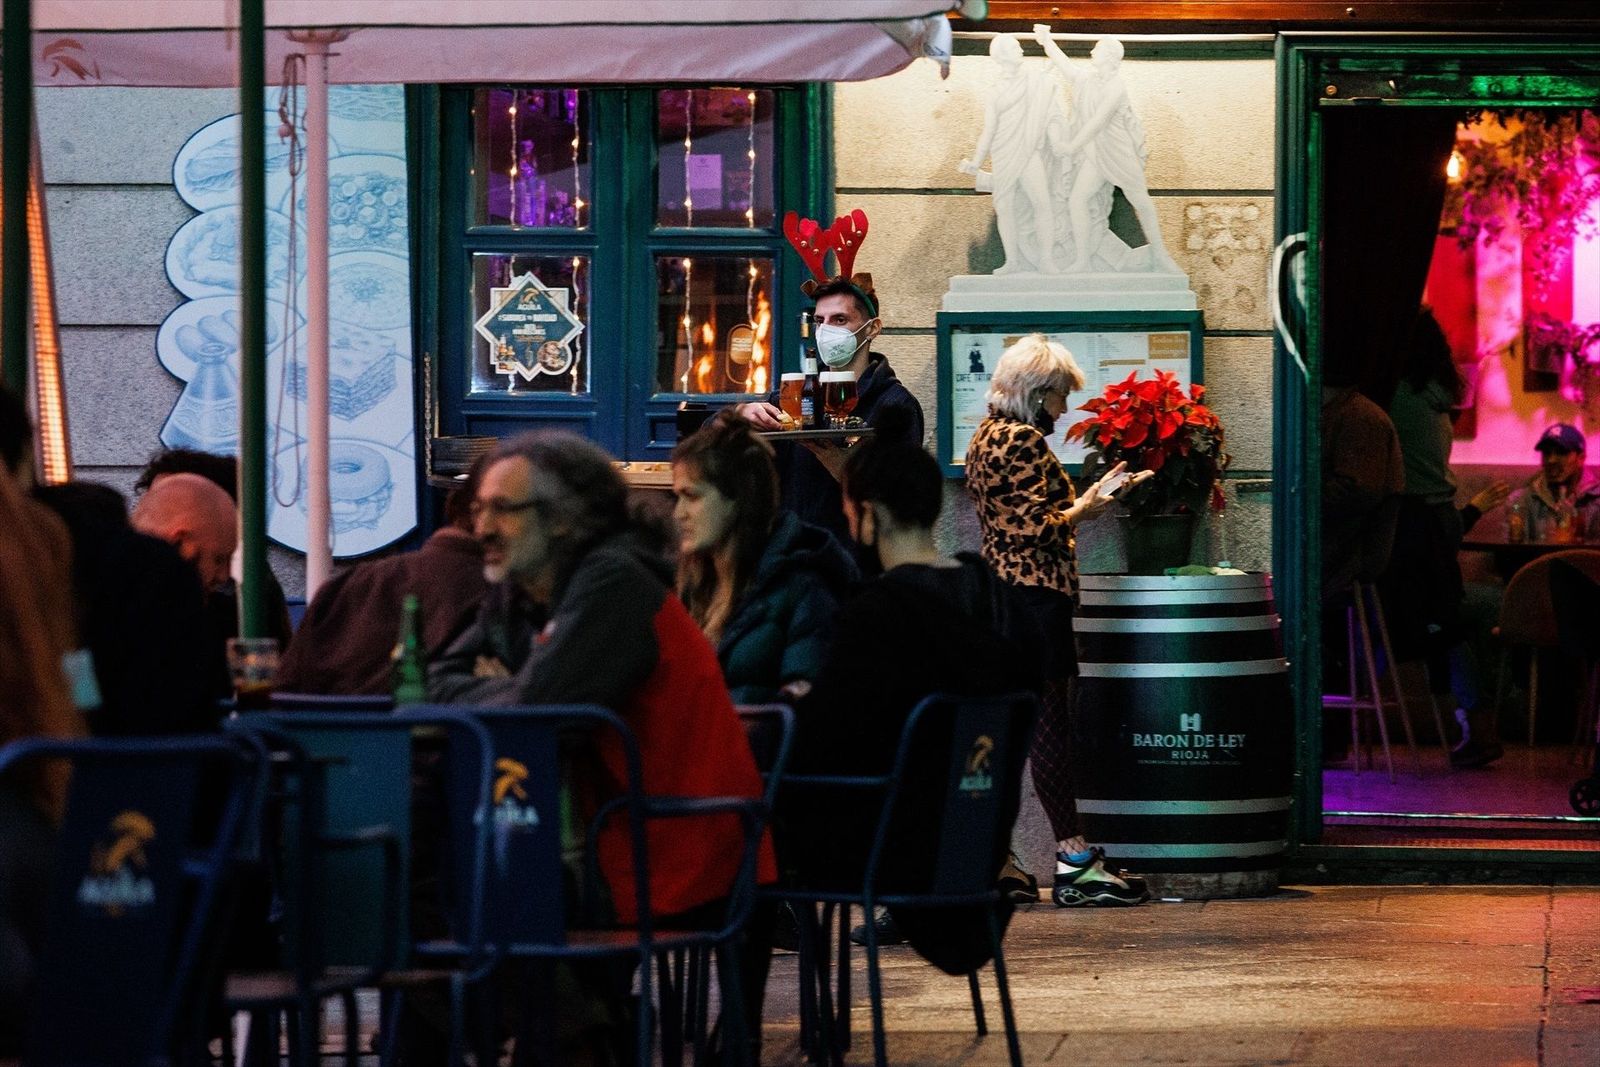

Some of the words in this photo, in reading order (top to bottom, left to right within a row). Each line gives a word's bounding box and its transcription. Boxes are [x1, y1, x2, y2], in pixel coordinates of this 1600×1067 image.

[1133, 733, 1189, 748] BARON
[1193, 734, 1216, 748] DE
[1218, 734, 1245, 748] LEY
[1171, 750, 1210, 759] RIOJA
